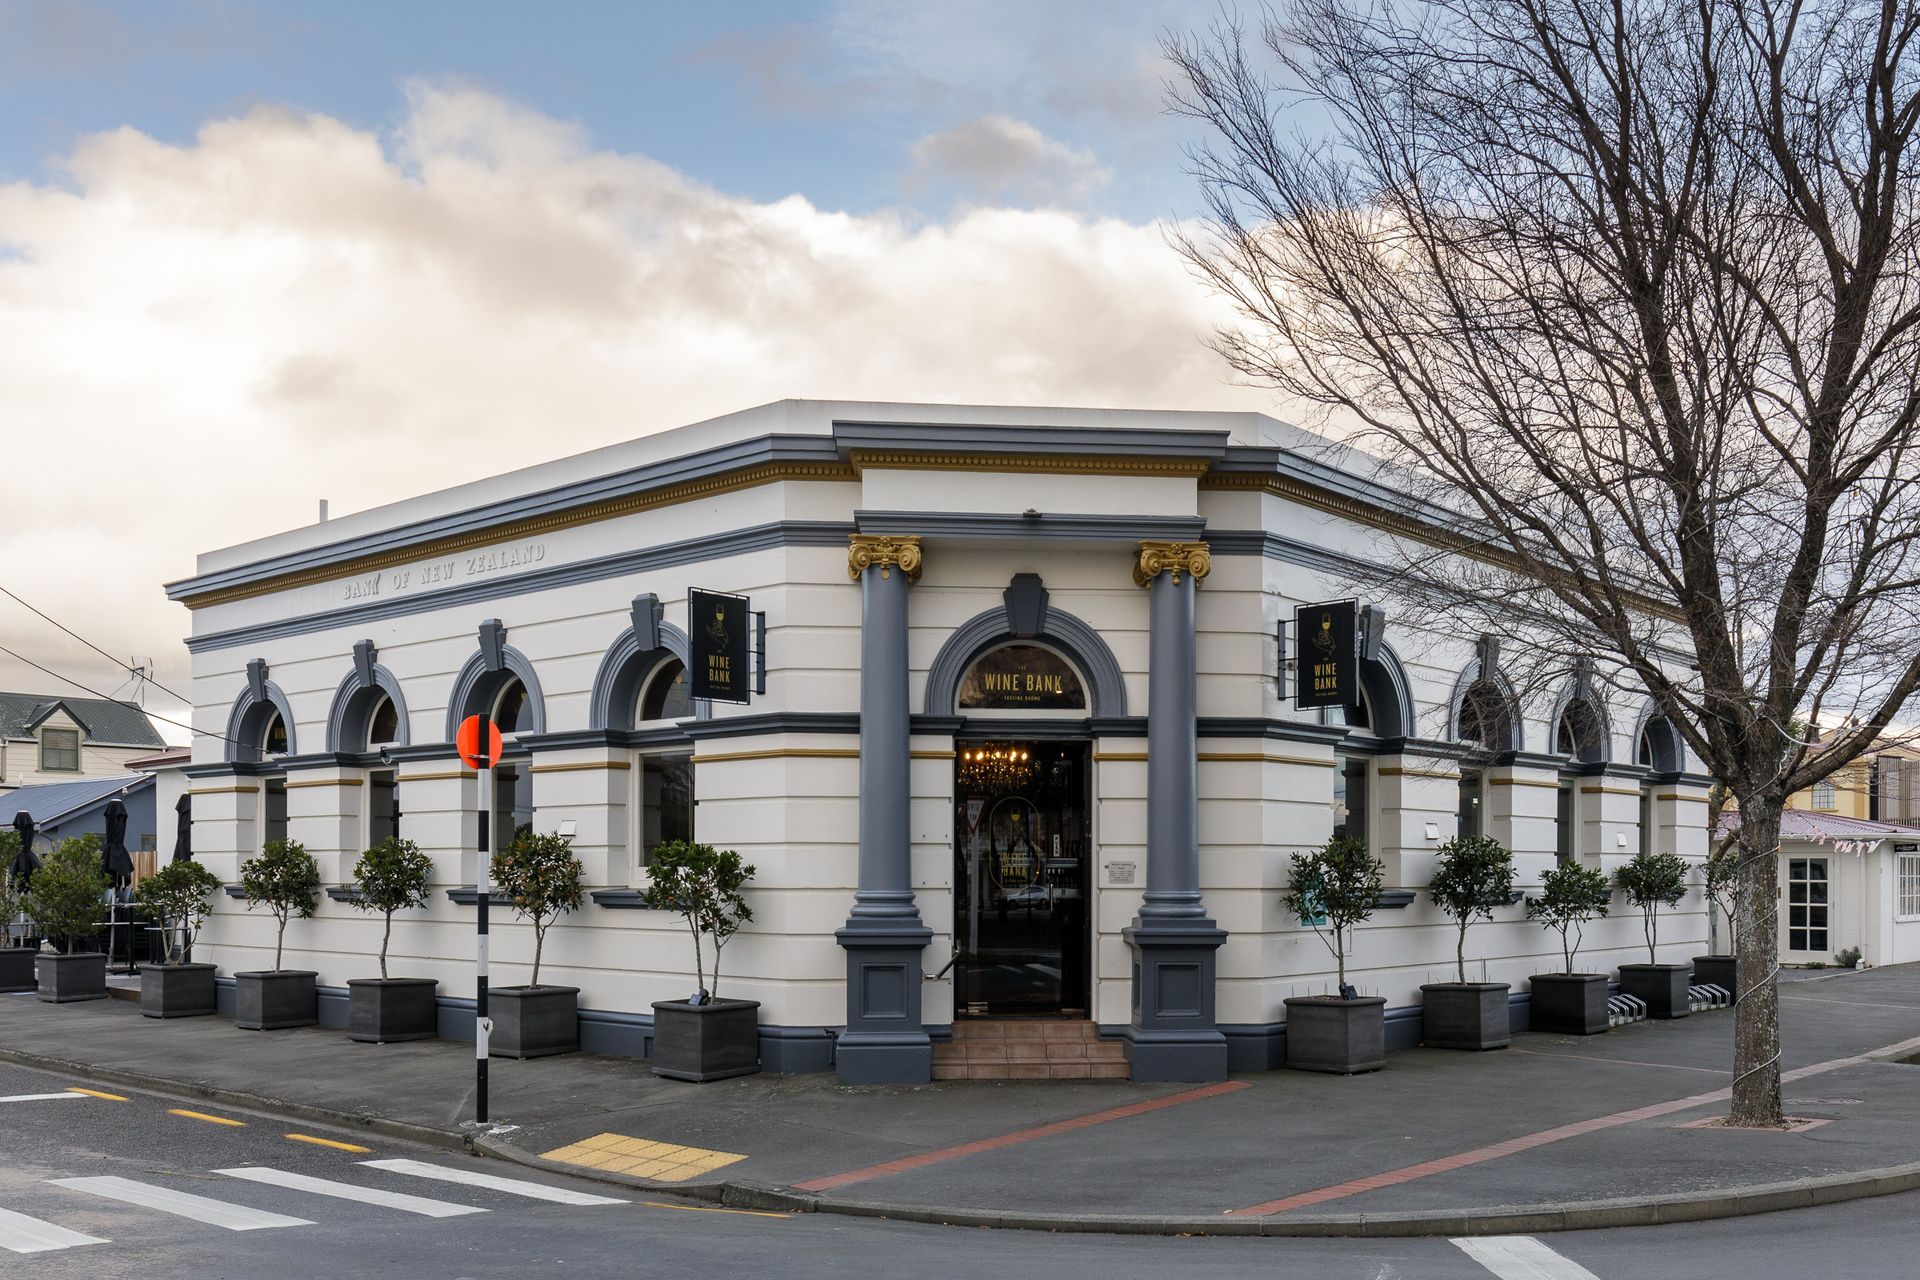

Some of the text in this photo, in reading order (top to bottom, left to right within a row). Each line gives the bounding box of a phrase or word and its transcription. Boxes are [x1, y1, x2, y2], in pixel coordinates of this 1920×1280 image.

[343, 543, 545, 600] BANK OF NEW ZEALAND
[708, 655, 730, 669] WINE
[709, 669, 730, 683] BANK
[1314, 663, 1336, 676] WINE
[985, 673, 1062, 692] WINE BANK
[1315, 676, 1336, 690] BANK
[1003, 866, 1027, 877] BANK
